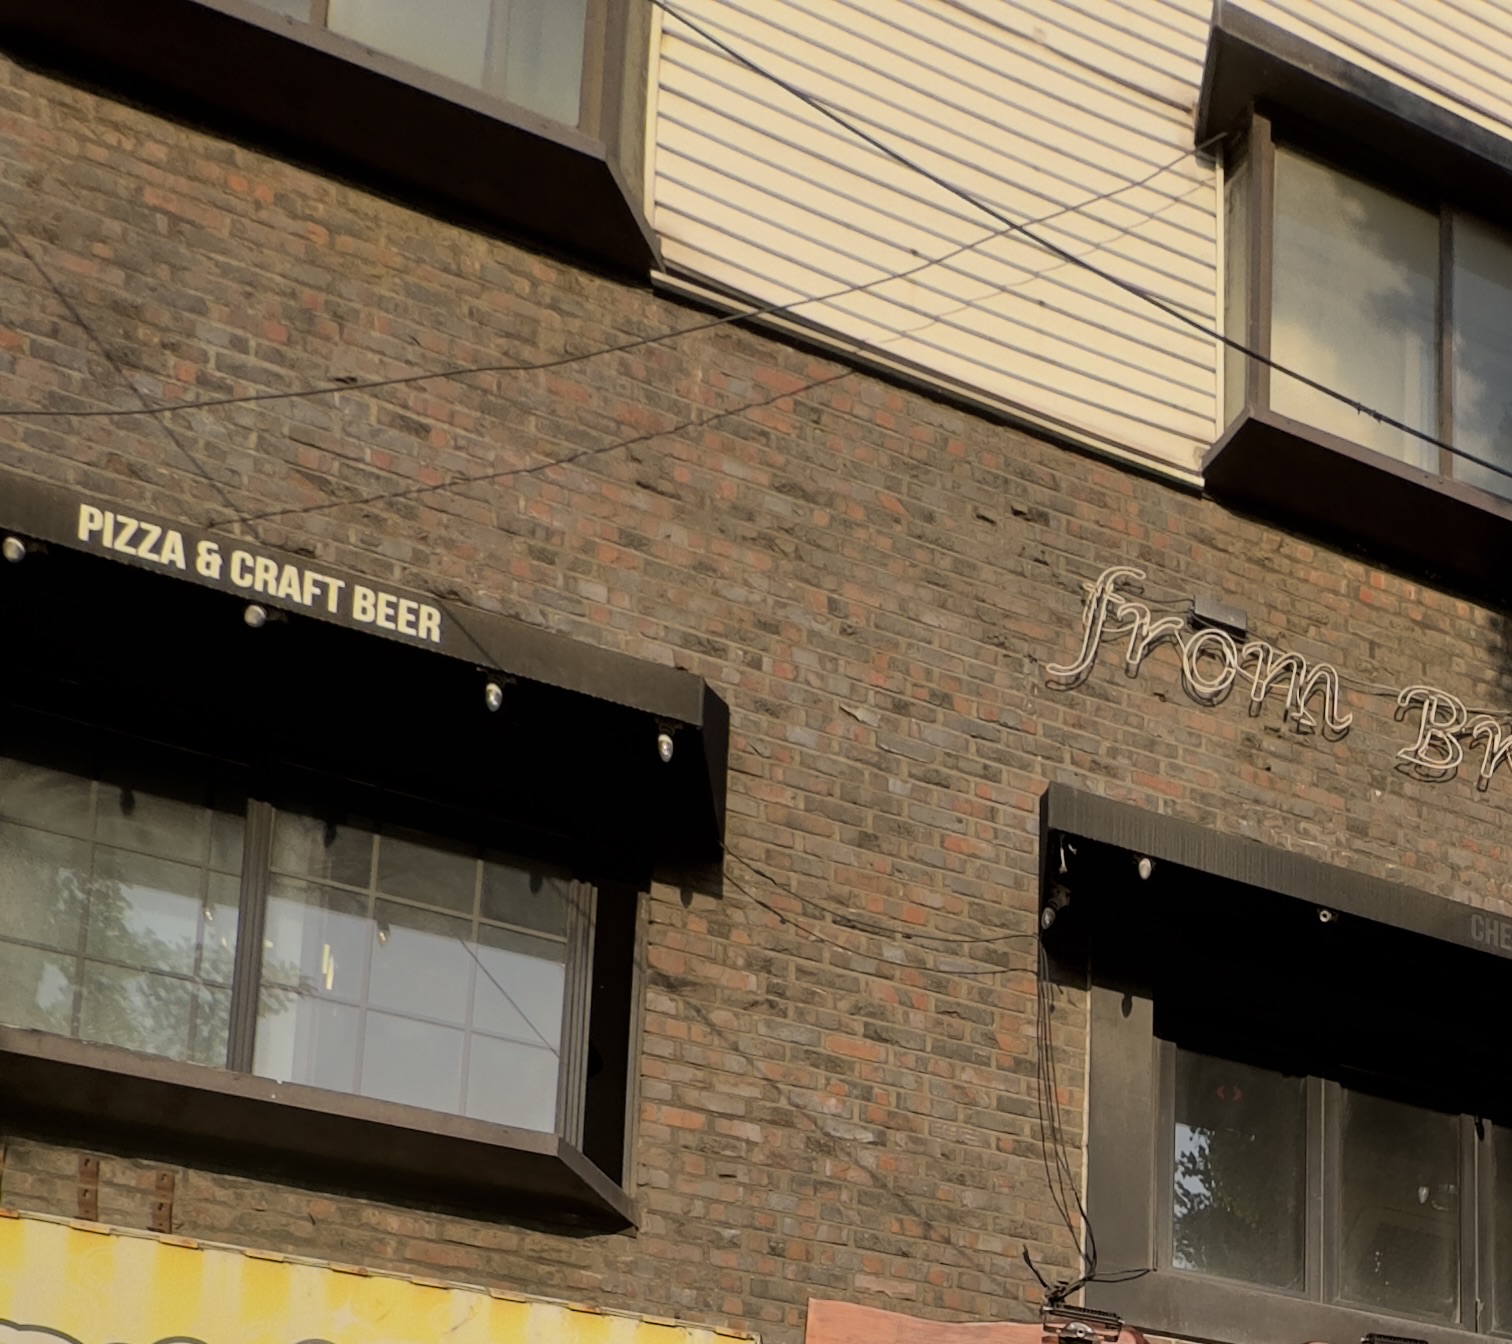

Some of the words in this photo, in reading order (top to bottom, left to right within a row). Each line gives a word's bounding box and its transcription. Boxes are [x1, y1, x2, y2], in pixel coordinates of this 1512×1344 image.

[78, 503, 186, 570] PIZZA
[196, 540, 222, 580] &
[230, 550, 345, 613] CRAFT
[352, 585, 442, 643] BEER
[1046, 566, 1352, 730] from
